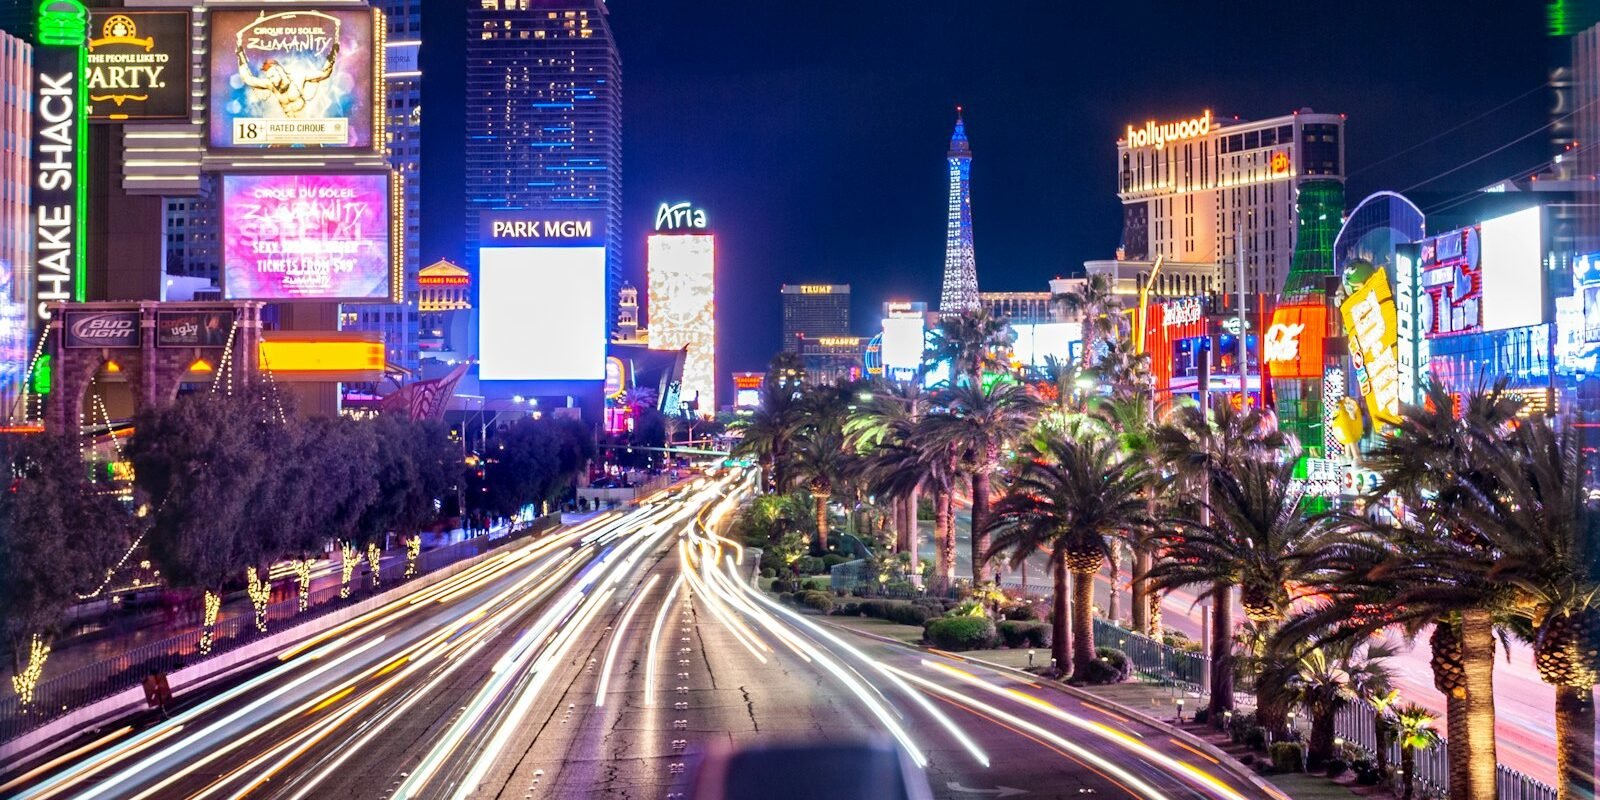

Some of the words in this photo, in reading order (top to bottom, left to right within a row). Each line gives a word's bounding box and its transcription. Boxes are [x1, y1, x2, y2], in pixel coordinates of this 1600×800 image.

[254, 27, 284, 36] CIRQUE
[285, 27, 297, 35] DU
[298, 27, 326, 35] SOLEIL
[247, 33, 332, 56] ZUMANITY
[87, 54, 105, 63] THE
[105, 54, 136, 63] PEOPLE
[136, 54, 156, 63] LIKE
[154, 53, 169, 62] TO
[39, 72, 74, 191] SHACK
[269, 124, 295, 132] RATED
[297, 124, 326, 132] CIRQUE
[1127, 109, 1210, 150] hollywood
[254, 188, 296, 200] CIRQUE
[299, 188, 317, 198] DU
[318, 188, 356, 198] SOLEIL
[655, 202, 706, 230] Aria
[493, 221, 540, 237] PARK
[544, 221, 592, 237] MGM
[801, 285, 832, 294] TRUMP
[89, 319, 133, 329] BUD
[171, 322, 198, 336] ugly
[79, 328, 135, 338] LIGHT
[819, 337, 860, 346] TREASURE
